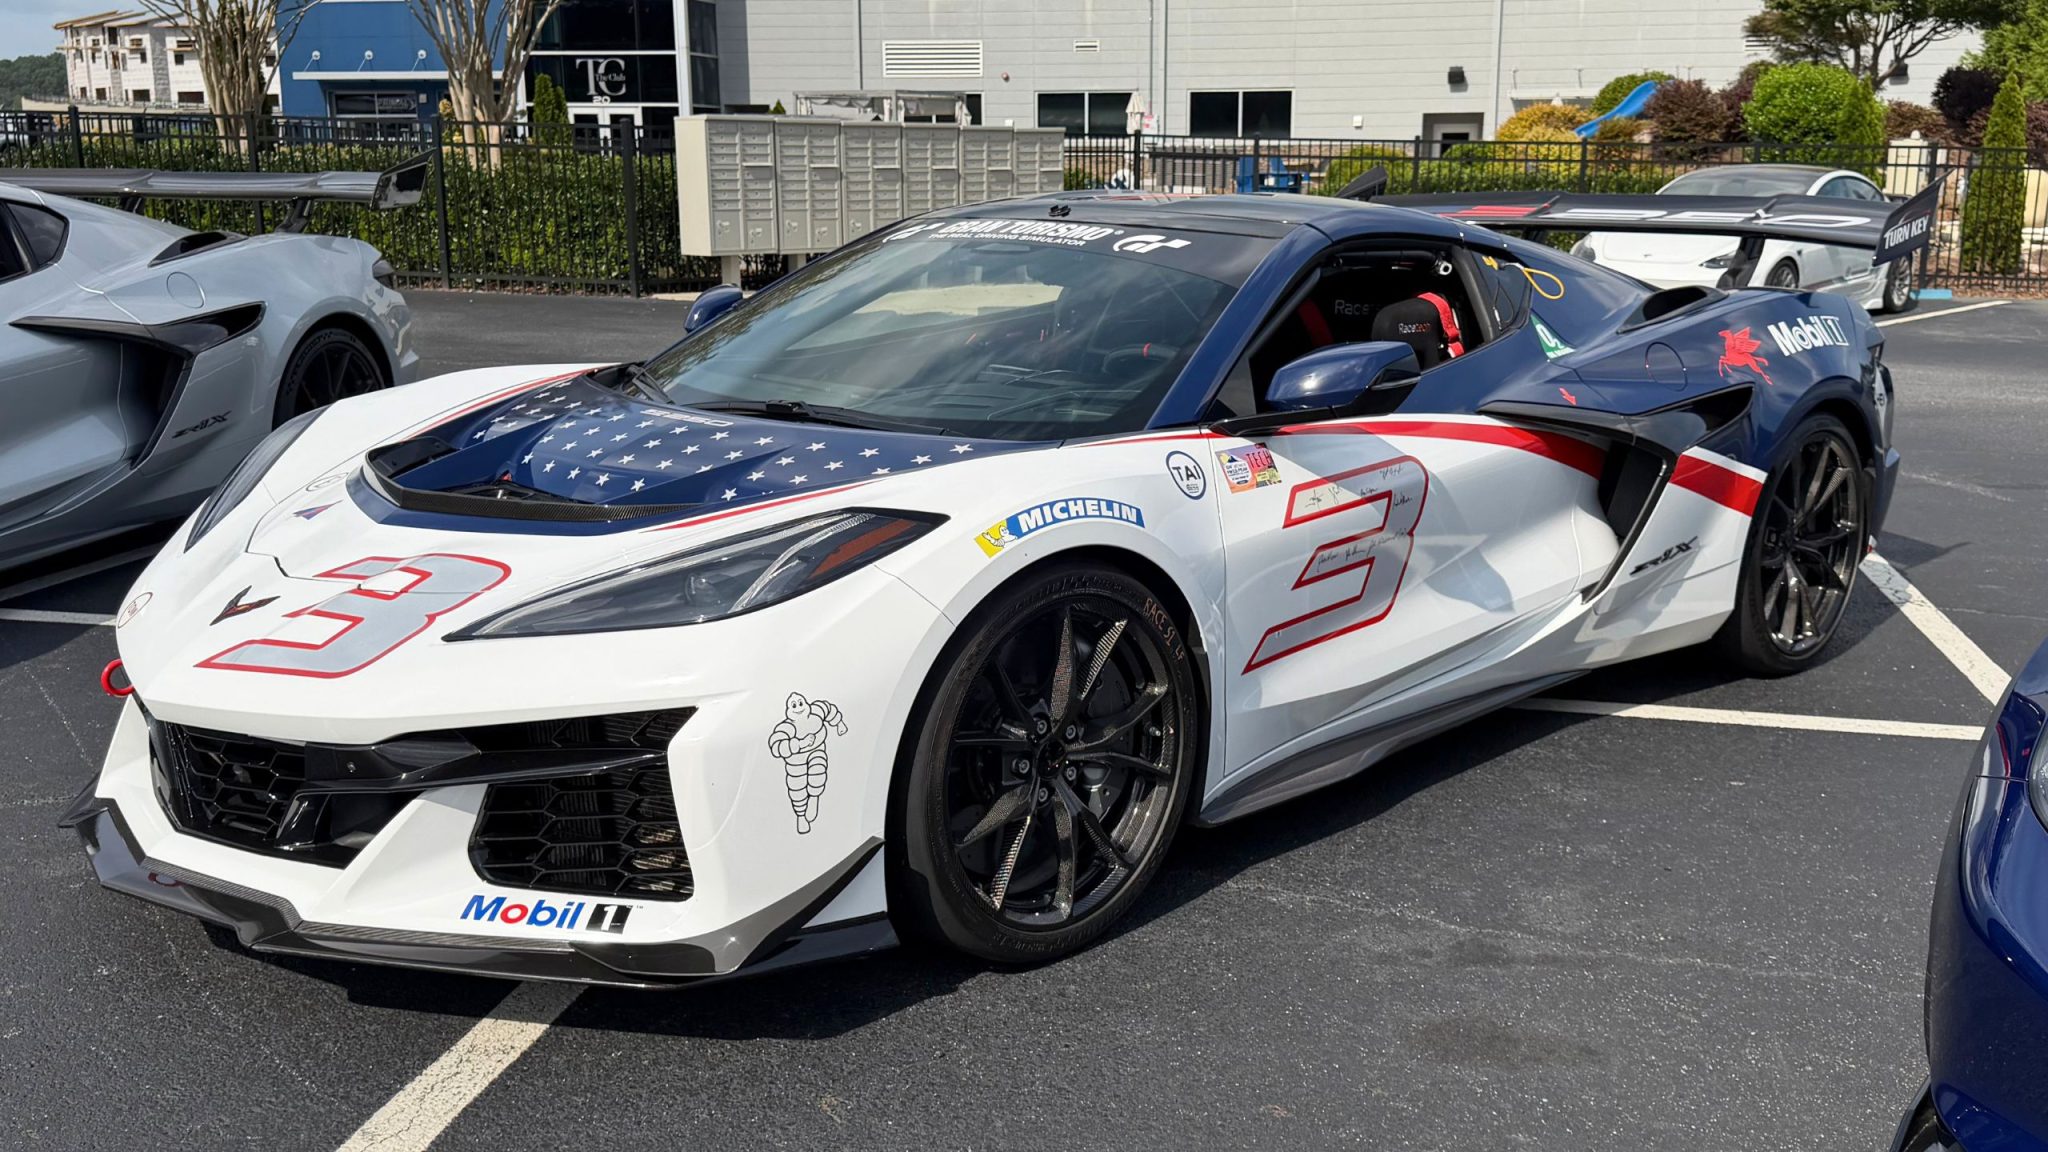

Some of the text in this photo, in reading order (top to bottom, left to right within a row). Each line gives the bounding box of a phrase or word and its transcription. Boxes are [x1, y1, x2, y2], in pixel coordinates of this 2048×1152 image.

[938, 221, 1011, 234] GRAN
[1018, 235, 1087, 247] SIMULATOR
[1883, 215, 1929, 249] TURN KEY
[1767, 316, 1834, 356] Mobil
[1172, 465, 1202, 482] TAI
[1246, 449, 1273, 469] TECH
[1018, 500, 1137, 533] MICHELIN
[1241, 455, 1429, 676] 3
[193, 553, 513, 679] 3
[1143, 598, 1168, 631] RACE
[460, 895, 586, 929] Mobil
